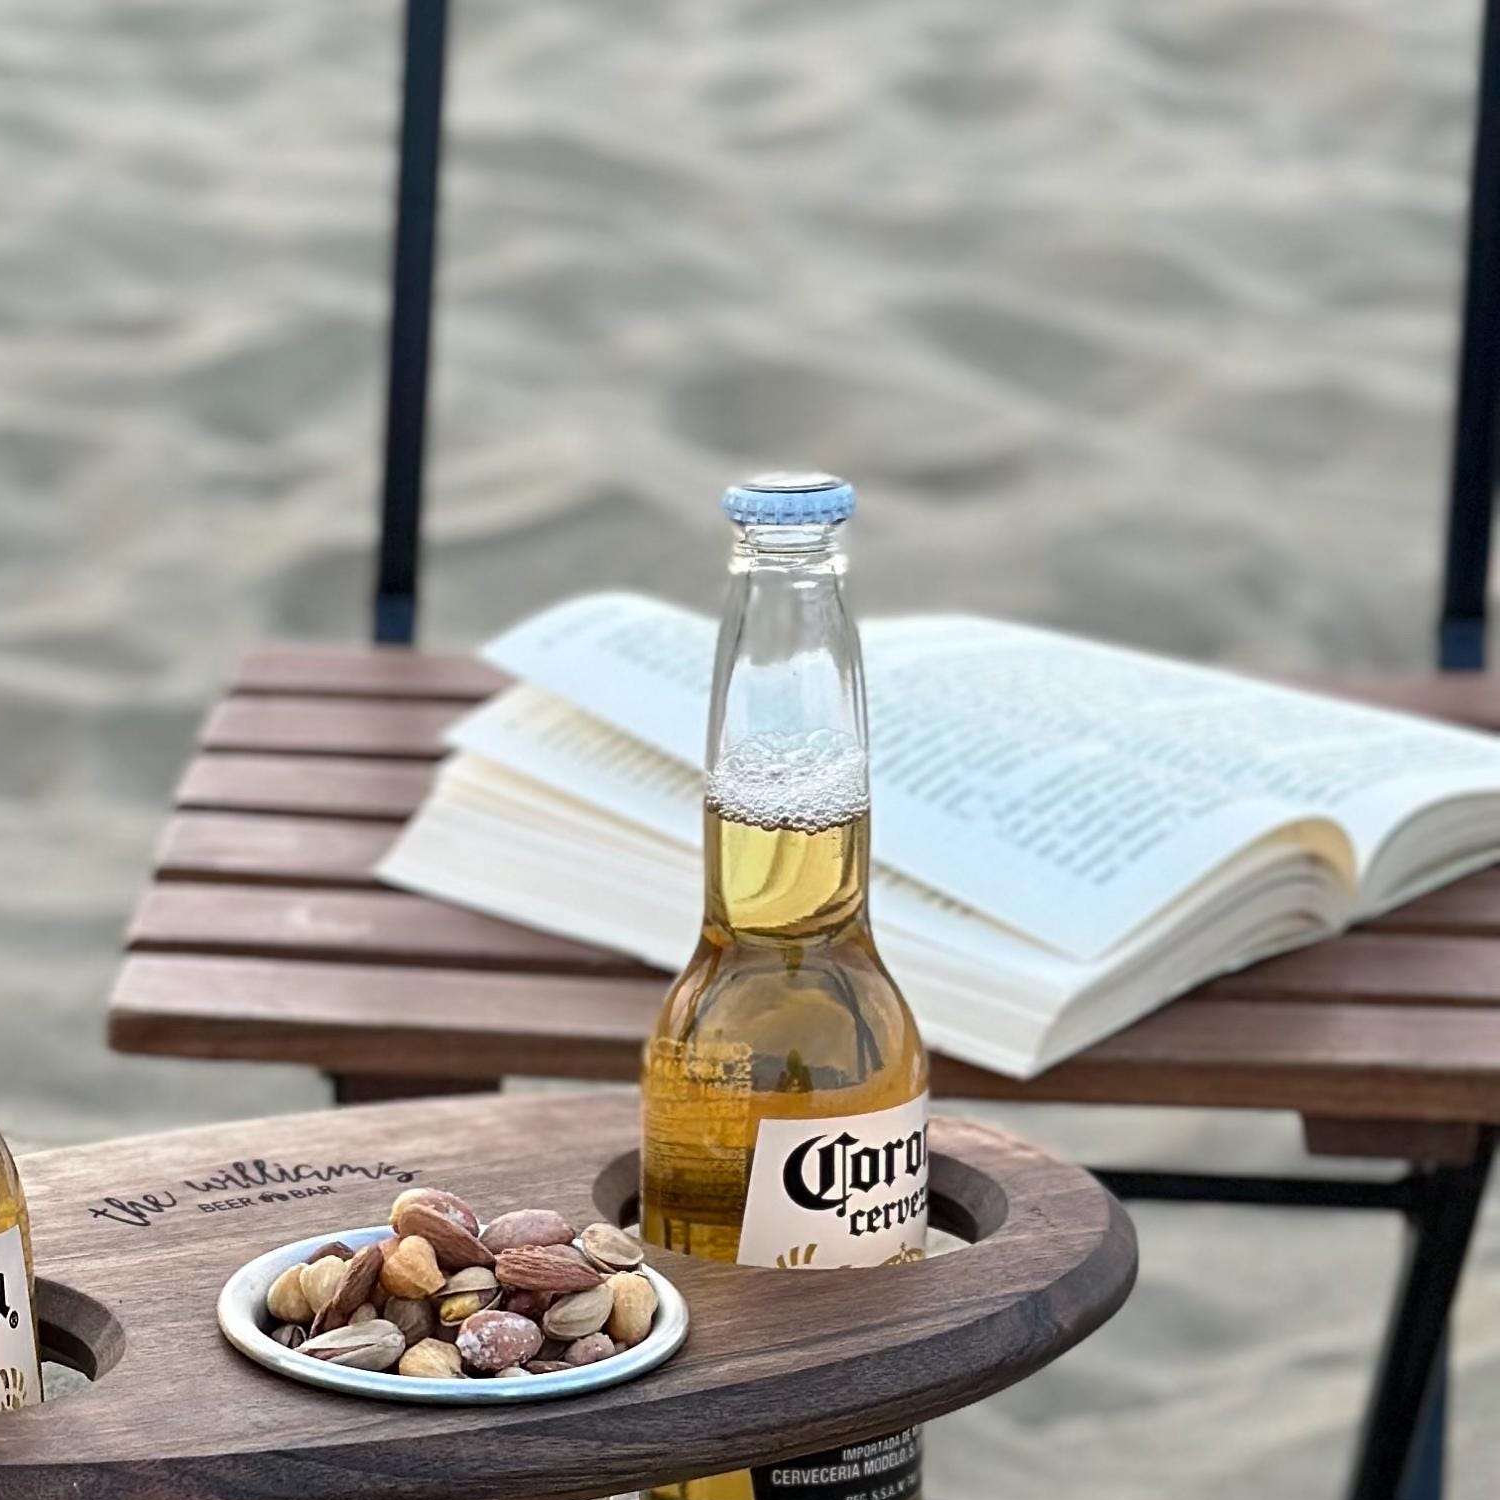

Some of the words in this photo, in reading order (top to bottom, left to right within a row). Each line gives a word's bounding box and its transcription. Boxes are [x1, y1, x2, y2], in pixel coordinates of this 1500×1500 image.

[783, 1124, 927, 1217] Coro
[88, 1191, 177, 1227] the
[198, 1197, 258, 1213] BEER
[288, 1185, 338, 1199] BAR
[849, 1187, 926, 1237] cerve
[772, 1464, 860, 1485] CERVECERIA
